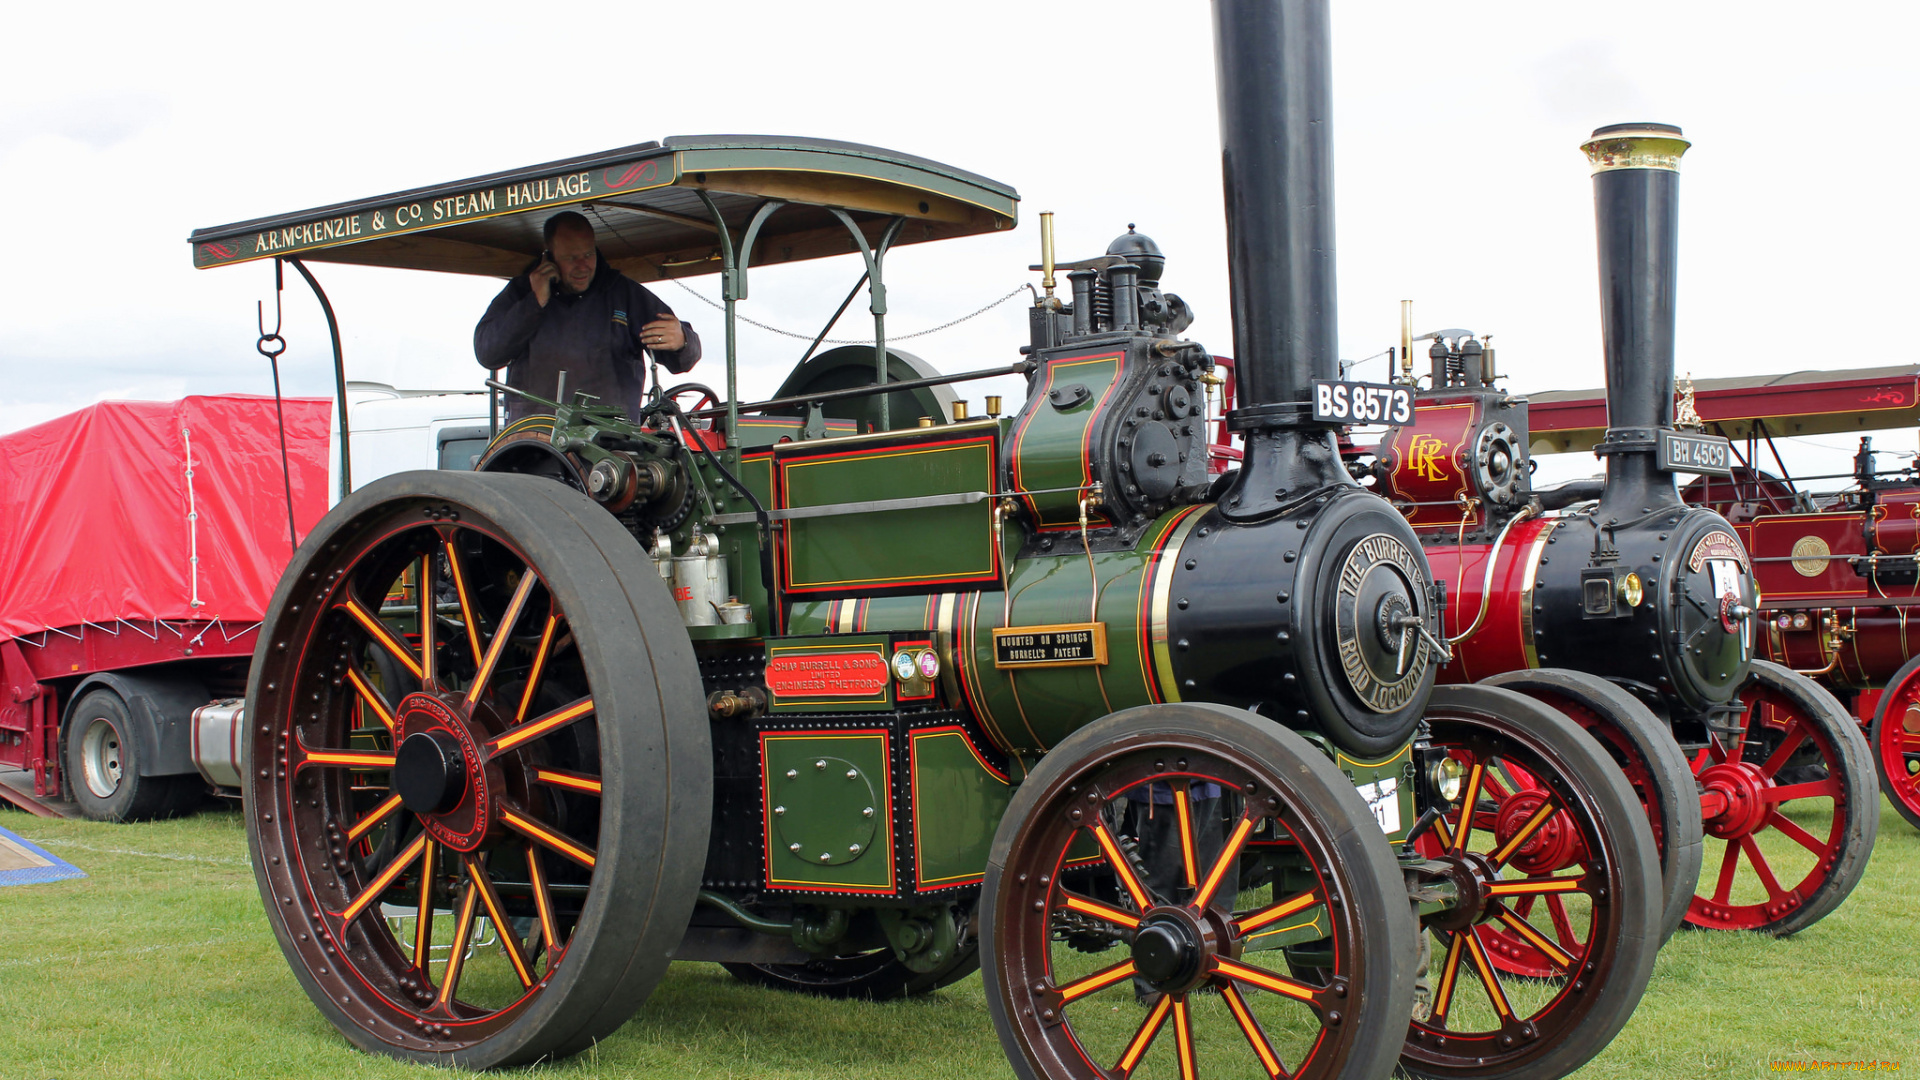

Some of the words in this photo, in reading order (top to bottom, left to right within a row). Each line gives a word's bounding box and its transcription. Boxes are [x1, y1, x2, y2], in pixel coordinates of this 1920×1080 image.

[372, 210, 387, 231] &
[432, 189, 496, 220] STEAM
[506, 172, 591, 207] HAULAGE
[1317, 384, 1349, 418] BS
[1352, 386, 1411, 423] 8573
[1673, 440, 1690, 463] BH
[1693, 443, 1724, 466] 4509
[1340, 556, 1366, 597] THE
[1001, 636, 1034, 647] MOUNTED
[1041, 635, 1050, 645] ON
[1056, 633, 1088, 644] SPRINGS
[800, 660, 841, 671] BURRELL
[843, 660, 850, 669] &
[852, 659, 878, 669] SONS
[1009, 649, 1046, 660] BURRELL'S
[1054, 647, 1081, 658] PATENT
[1340, 638, 1371, 692] ROAD
[775, 680, 826, 691] ENGINEERS
[829, 679, 880, 689] THETFORD
[811, 671, 841, 679] LIMITED
[409, 698, 451, 723] ENGINEERS
[450, 720, 478, 773] THETFORD
[474, 776, 485, 832] ENGLAND
